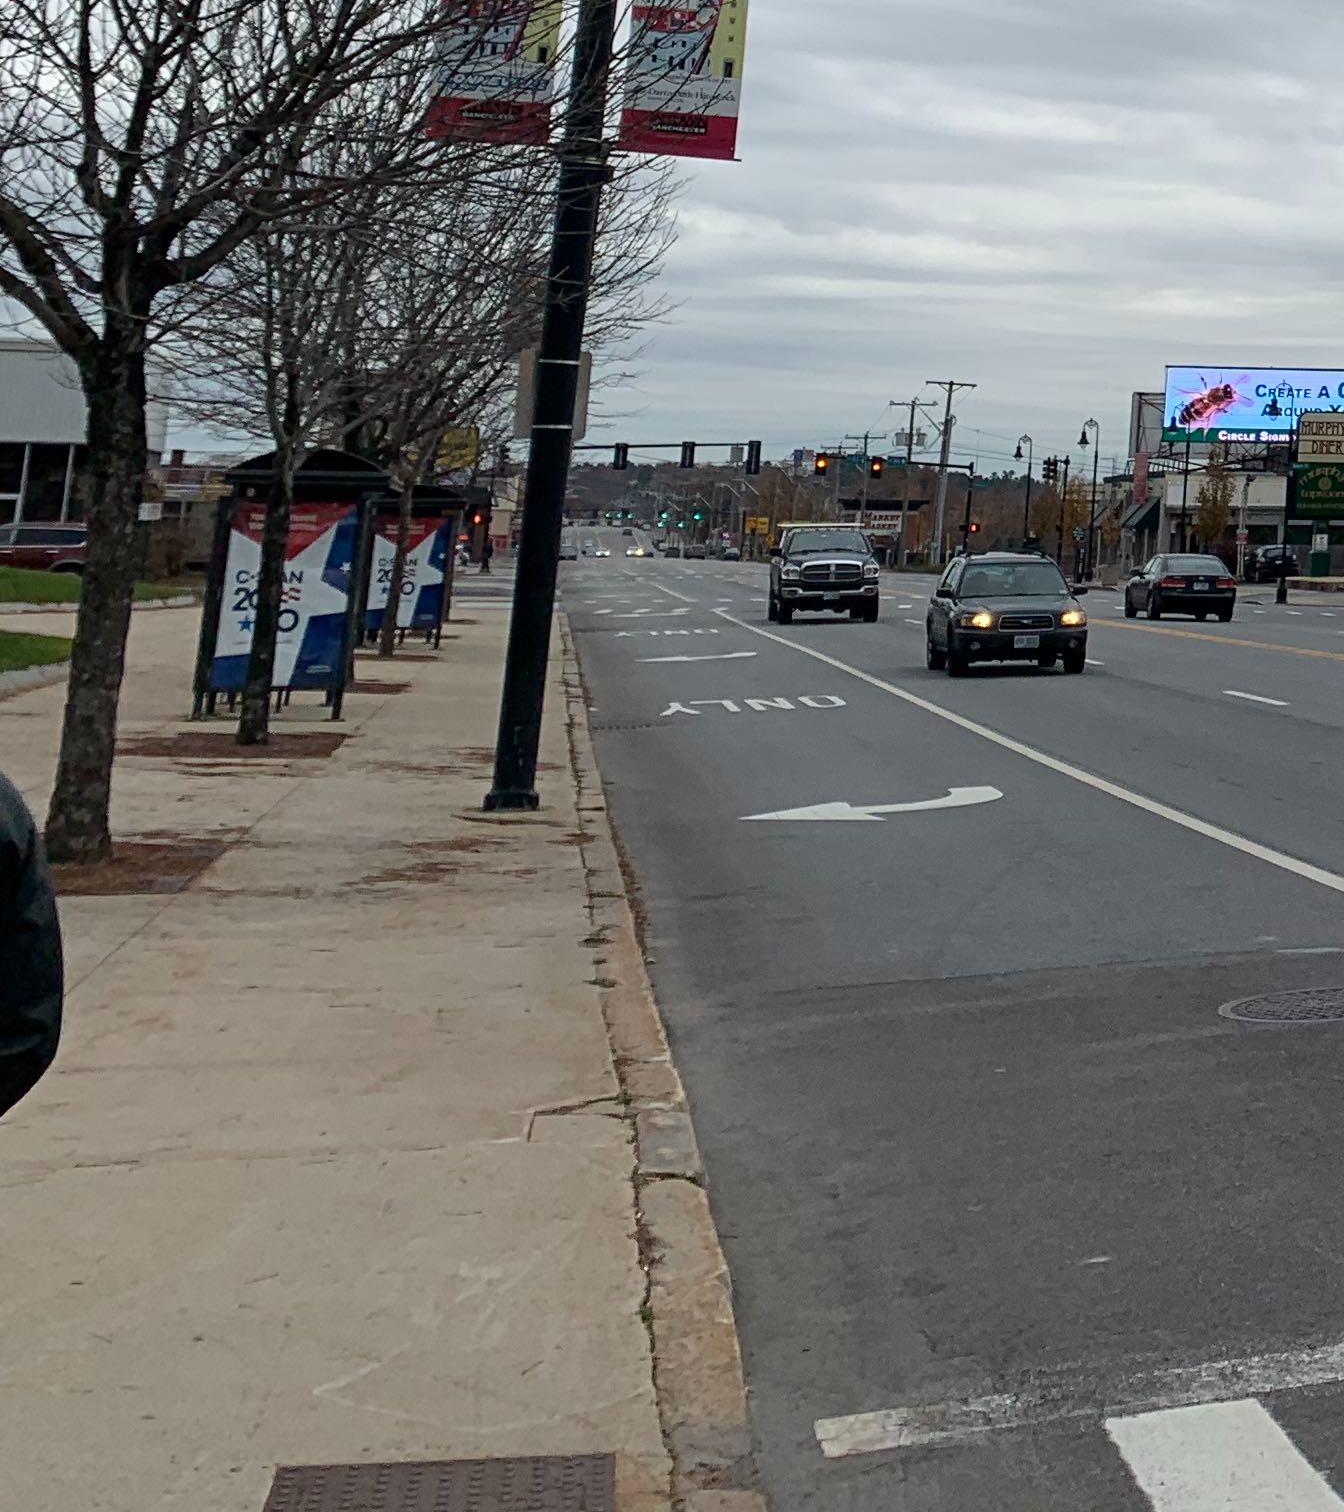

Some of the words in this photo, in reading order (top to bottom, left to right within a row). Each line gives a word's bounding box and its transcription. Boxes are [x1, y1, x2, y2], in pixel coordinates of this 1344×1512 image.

[1317, 386, 1330, 398] A
[1218, 430, 1255, 442] CIRCLE
[1312, 441, 1342, 454] DINER
[864, 512, 901, 521] MARKET
[659, 695, 847, 717] ONLY
